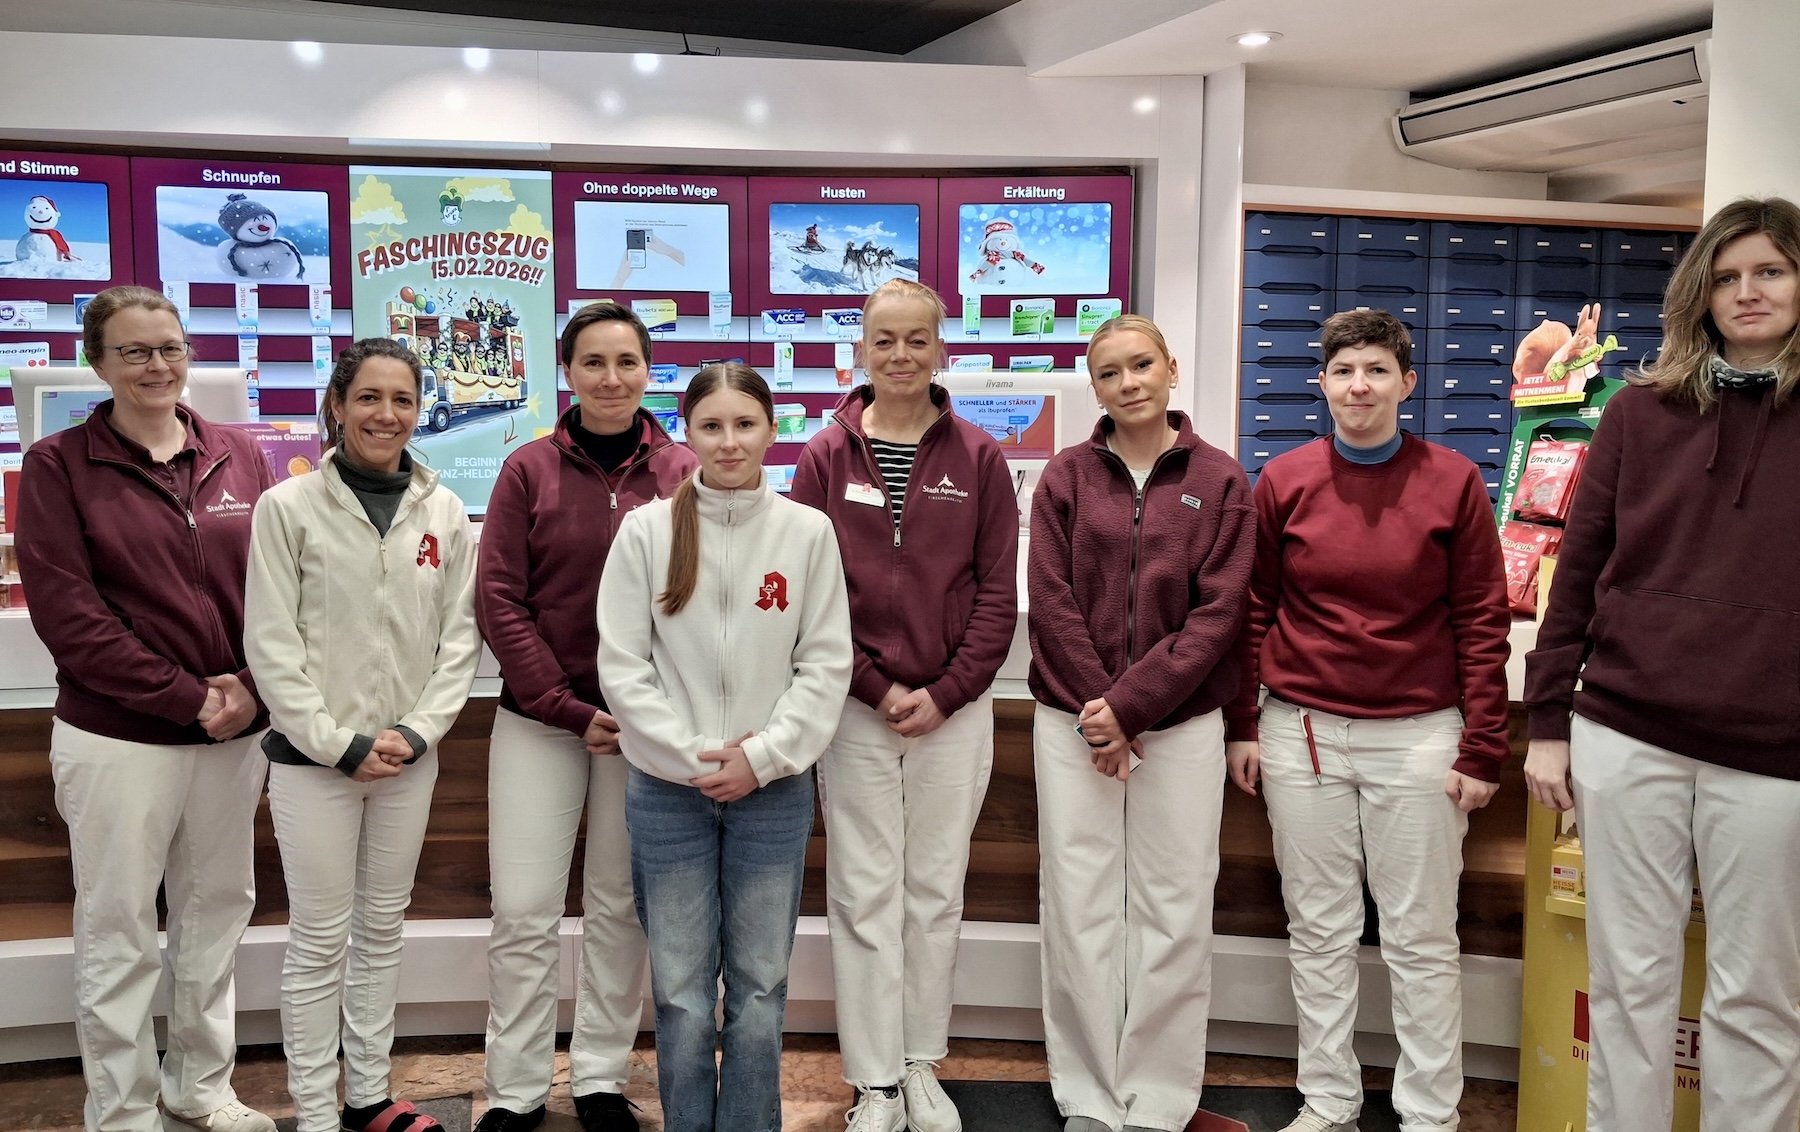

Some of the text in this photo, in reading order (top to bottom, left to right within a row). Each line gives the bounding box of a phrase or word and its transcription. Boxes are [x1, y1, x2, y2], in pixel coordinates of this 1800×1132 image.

[0, 160, 79, 176] nd Stimme
[202, 169, 281, 185] Schnupfen
[583, 181, 718, 199] Ohne doppelte Wege
[820, 186, 866, 199] Husten
[1003, 185, 1066, 200] Erkältung
[357, 231, 550, 277] FASCHINGSZUG
[430, 257, 545, 286] 15.02.2026!!
[776, 314, 794, 322] ACC
[838, 315, 856, 323] ACC
[985, 379, 1014, 388] iiyama
[1523, 376, 1545, 385] JETZT
[1514, 385, 1566, 396] MITNEHMEN!
[1008, 398, 1037, 406] STÄRKER
[256, 433, 312, 441] etwas Gutes!
[455, 457, 497, 467] BEGINN
[1506, 438, 1525, 489] VORRAT
[922, 485, 940, 494] Stadt
[206, 503, 226, 513] Stadt
